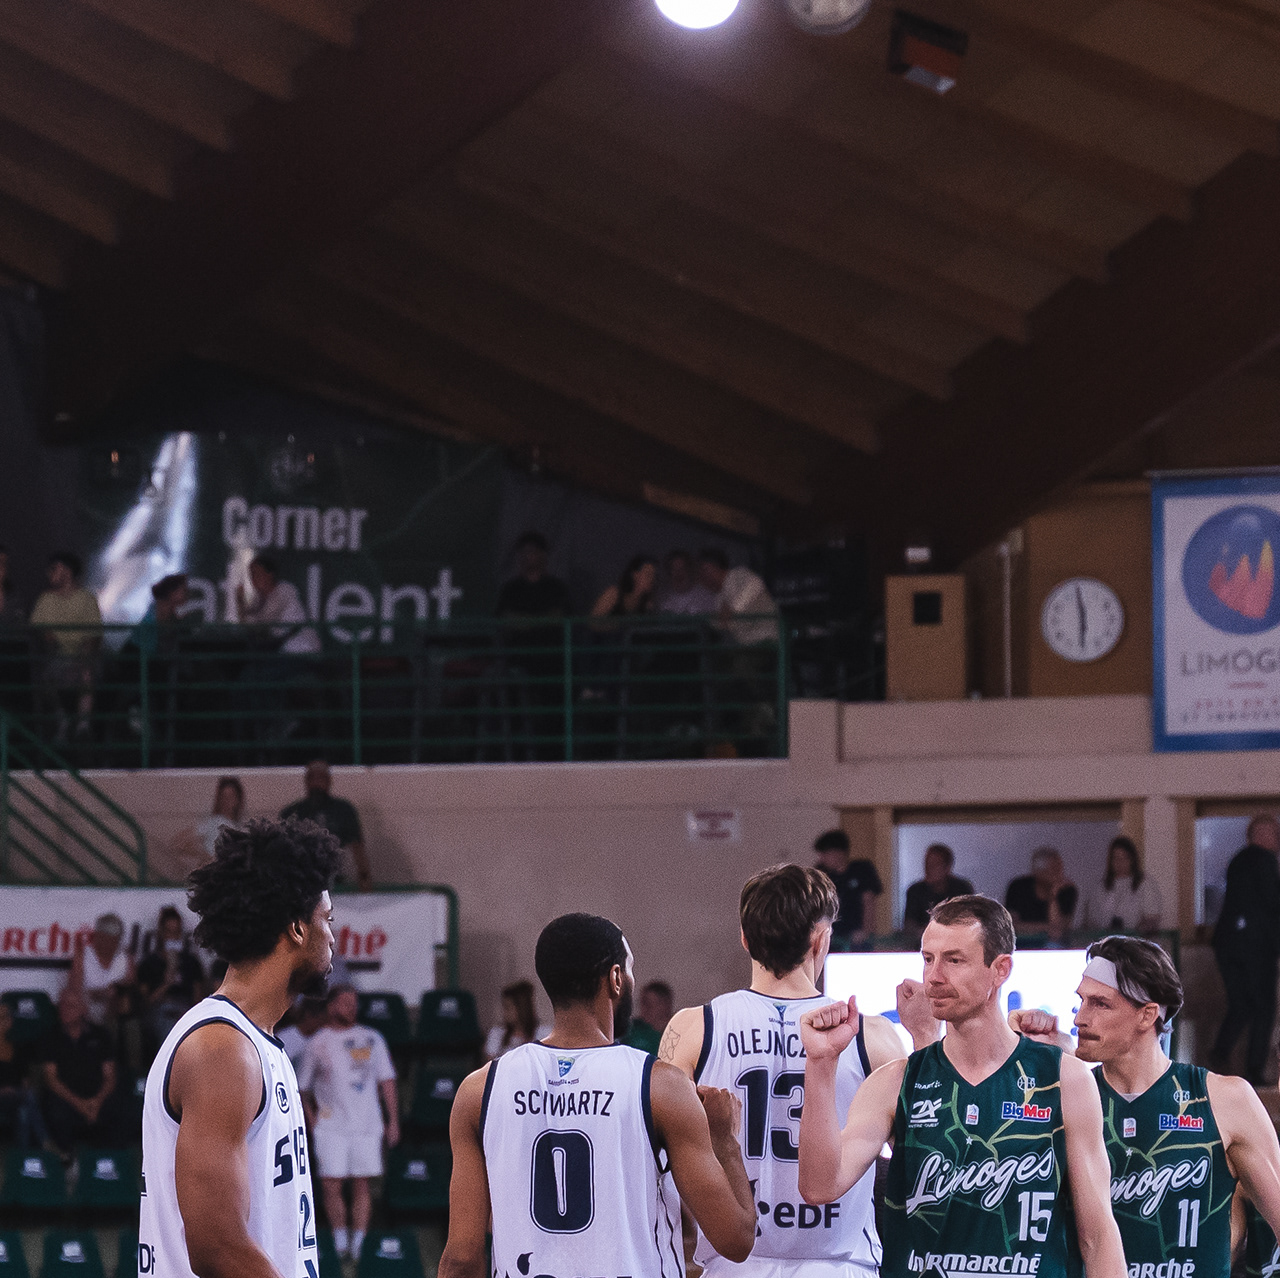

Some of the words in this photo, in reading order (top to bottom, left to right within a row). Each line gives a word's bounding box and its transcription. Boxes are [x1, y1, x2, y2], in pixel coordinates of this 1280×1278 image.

[222, 497, 367, 550] Corner
[735, 1066, 806, 1163] 13
[1003, 1102, 1051, 1119] BigMat
[1160, 1114, 1204, 1129] BigMat
[529, 1128, 596, 1235] 0
[906, 1148, 1054, 1216] Limoges
[1111, 1157, 1209, 1217] moges
[1018, 1191, 1055, 1242] 15
[1178, 1198, 1200, 1248] 11
